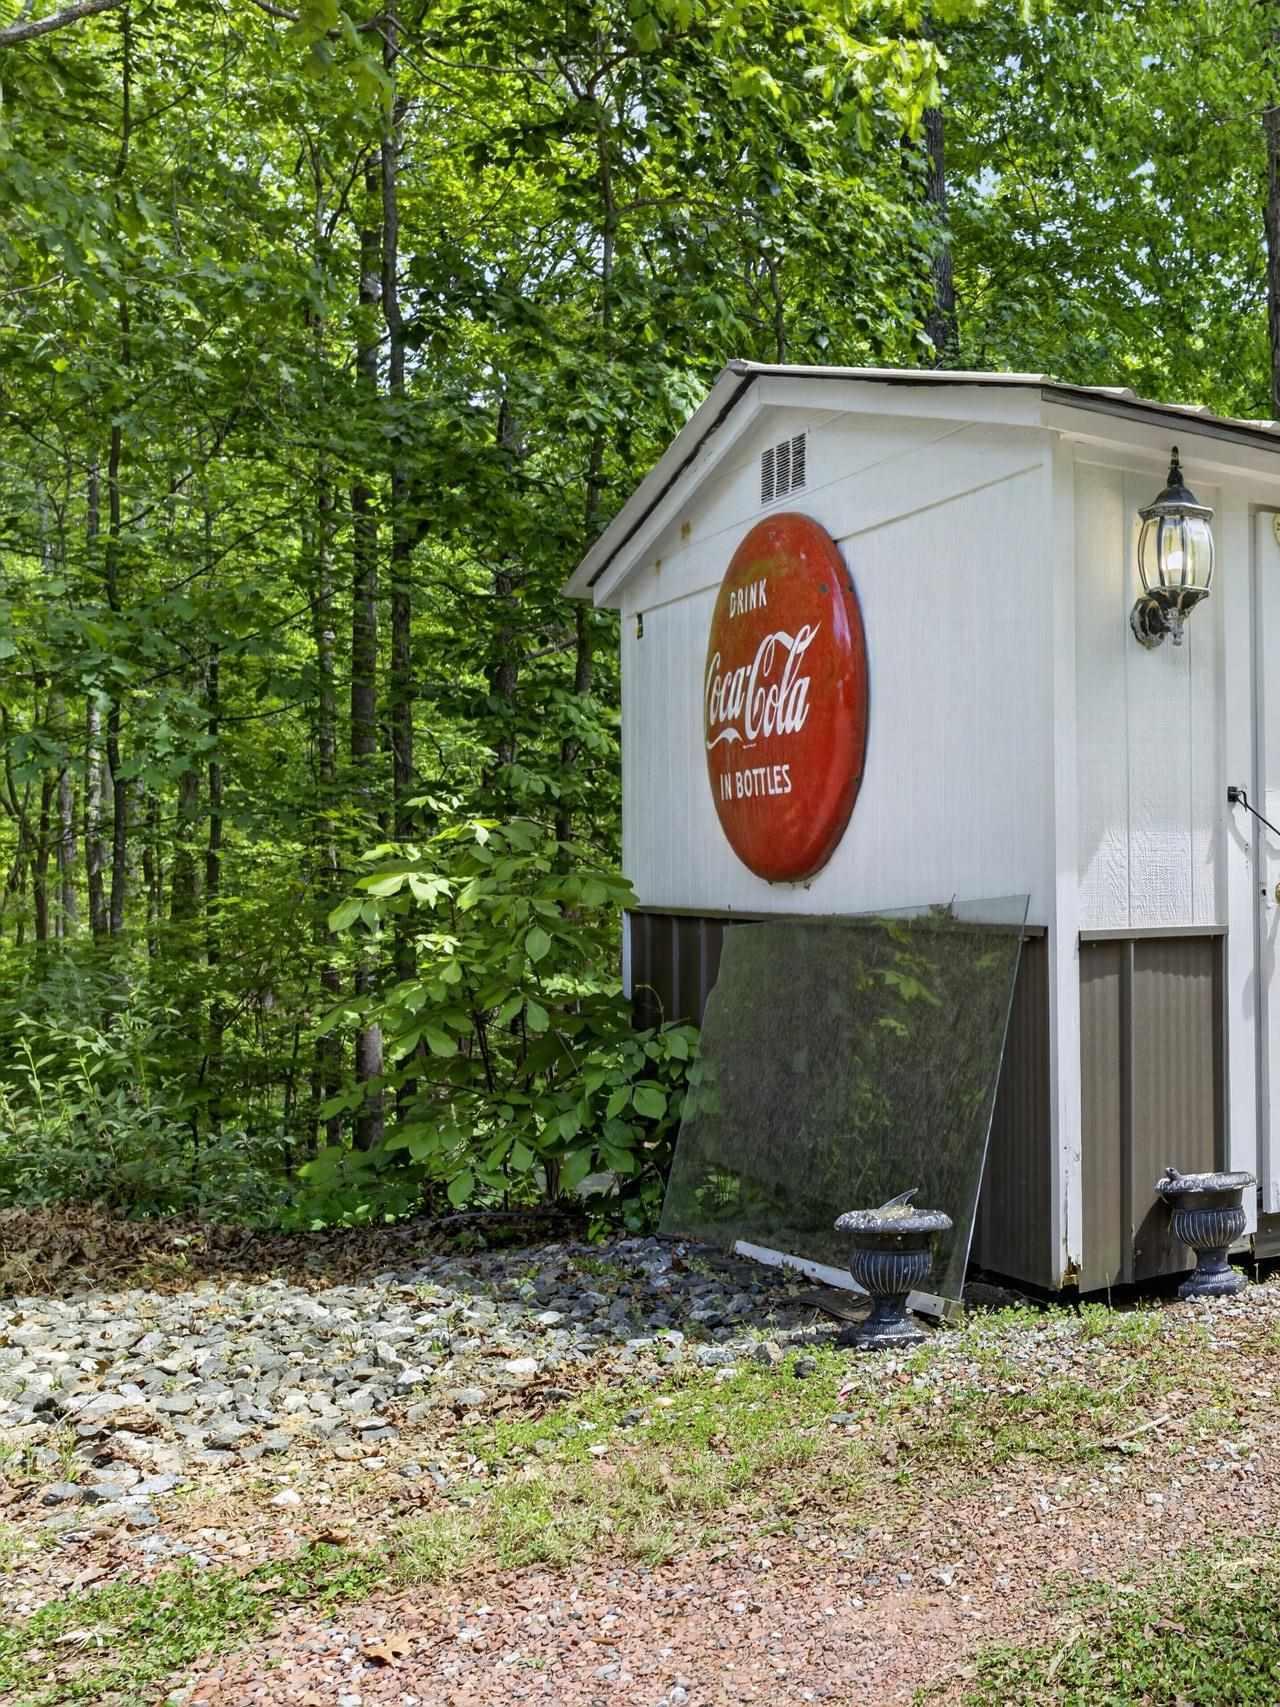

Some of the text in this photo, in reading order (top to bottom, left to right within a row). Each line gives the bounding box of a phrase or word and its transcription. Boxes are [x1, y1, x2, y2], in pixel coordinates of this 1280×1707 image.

[729, 578, 767, 618] DRINK
[705, 621, 821, 748] Coca-Cola
[720, 764, 792, 801] IN BOTTLES
